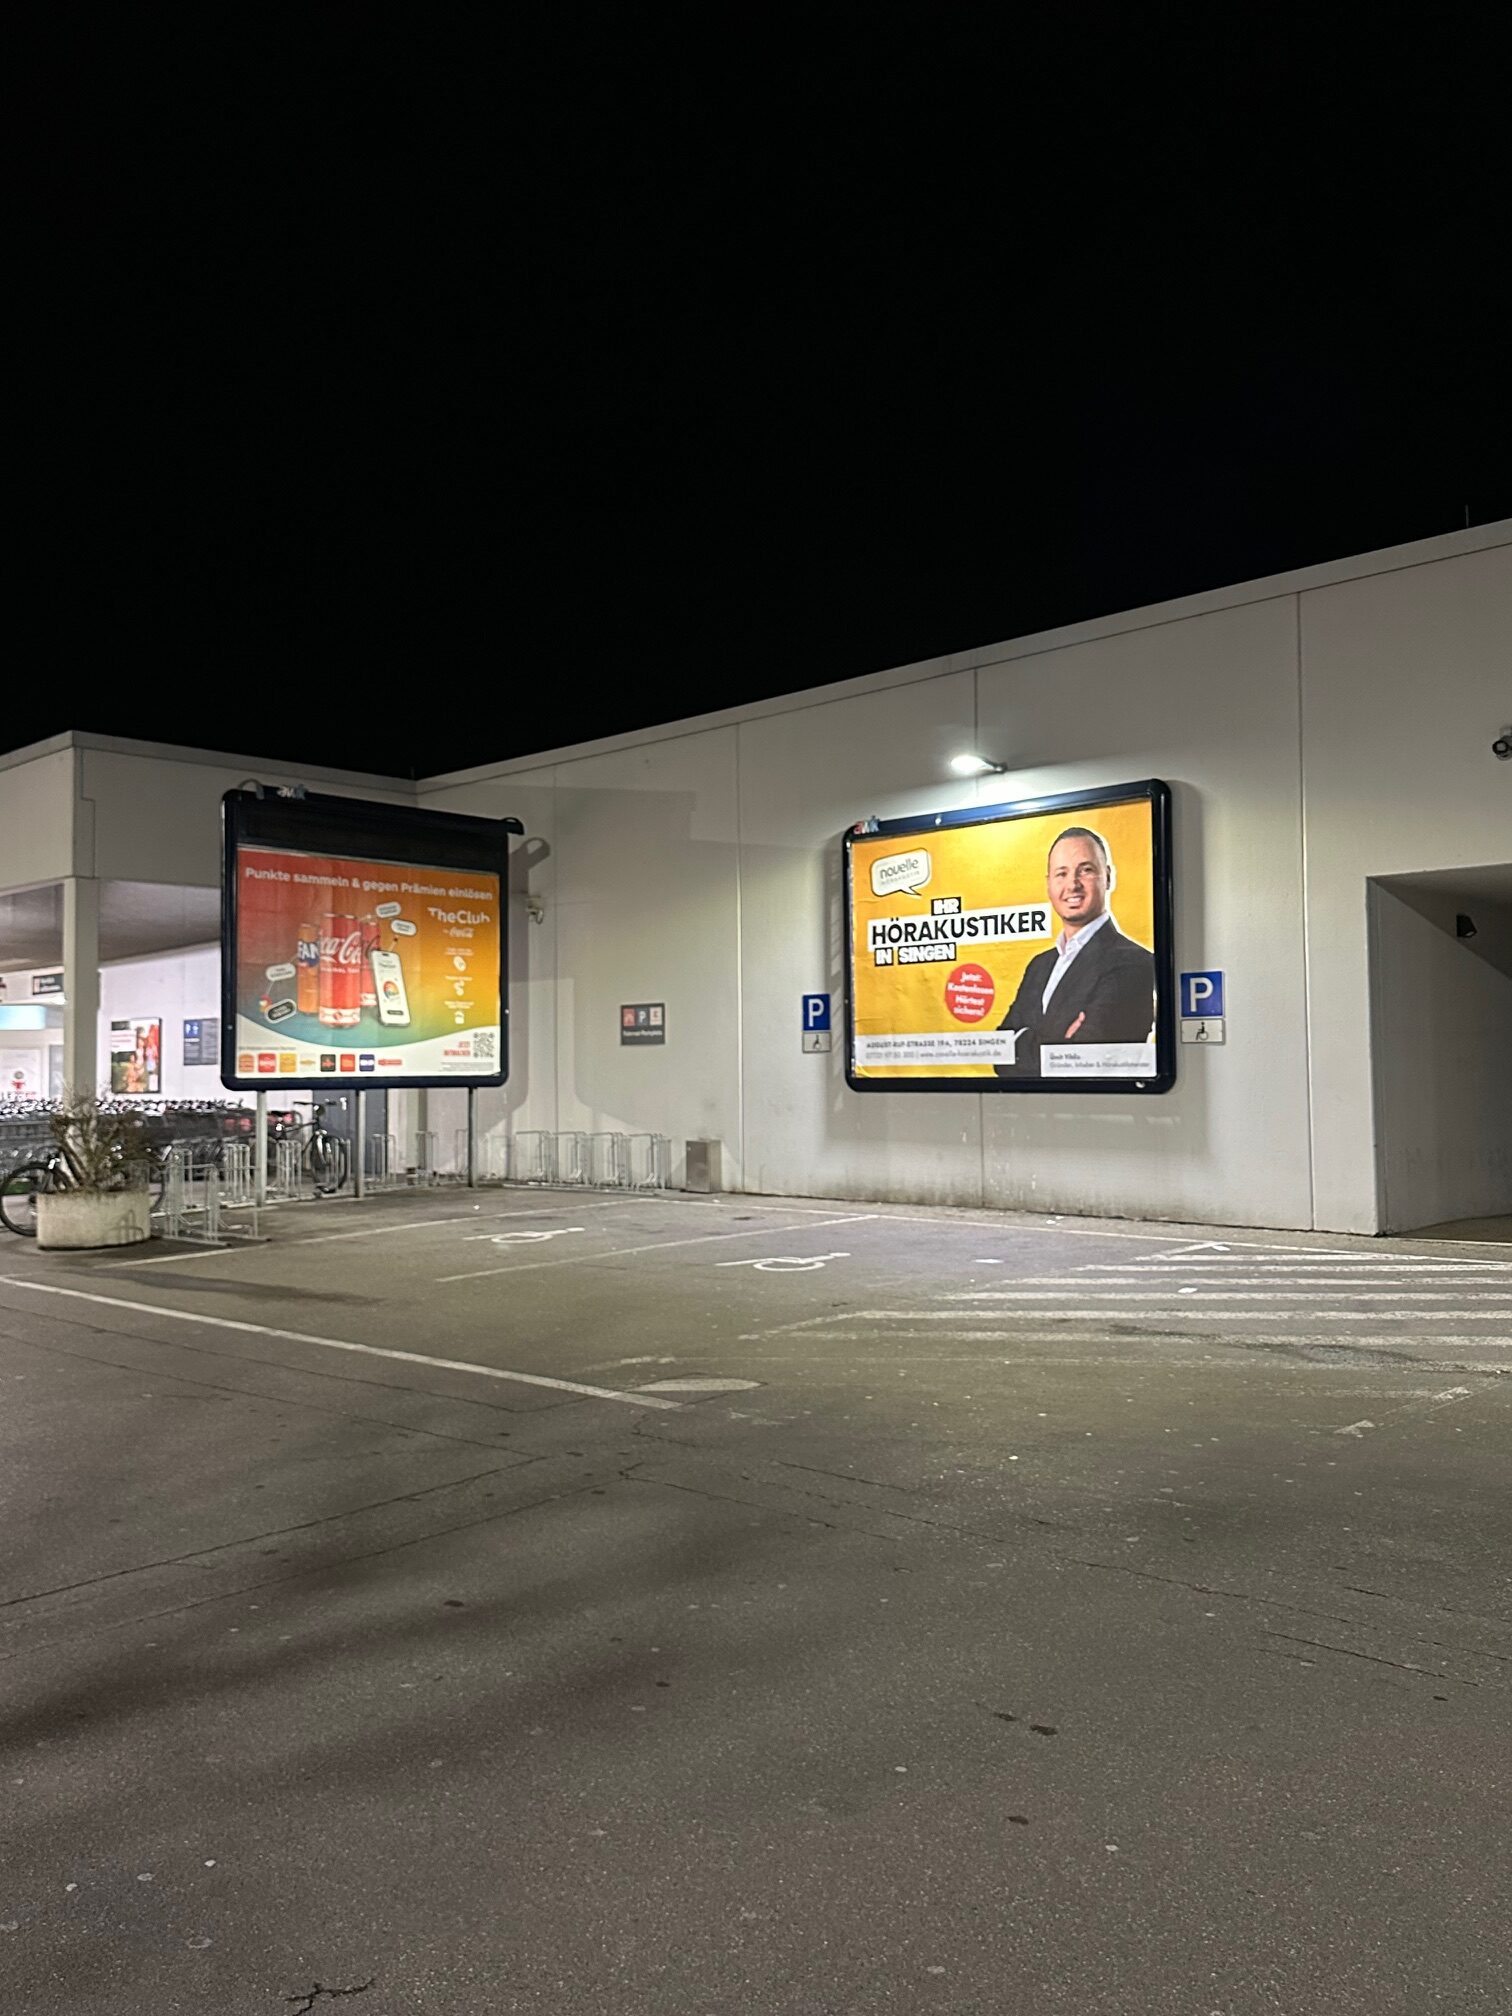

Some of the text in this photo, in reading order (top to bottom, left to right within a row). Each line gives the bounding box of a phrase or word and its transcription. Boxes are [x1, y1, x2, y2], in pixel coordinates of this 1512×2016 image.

[245, 867, 493, 900] Punkte sammeln & gegen Prämien einlösen
[933, 898, 960, 914] IHR
[872, 911, 1046, 945] HÖRAKUSTIKER
[875, 944, 956, 965] IN SINGEN
[1190, 977, 1213, 1012] P
[808, 998, 825, 1027] P
[978, 1037, 1007, 1046] SINGEN
